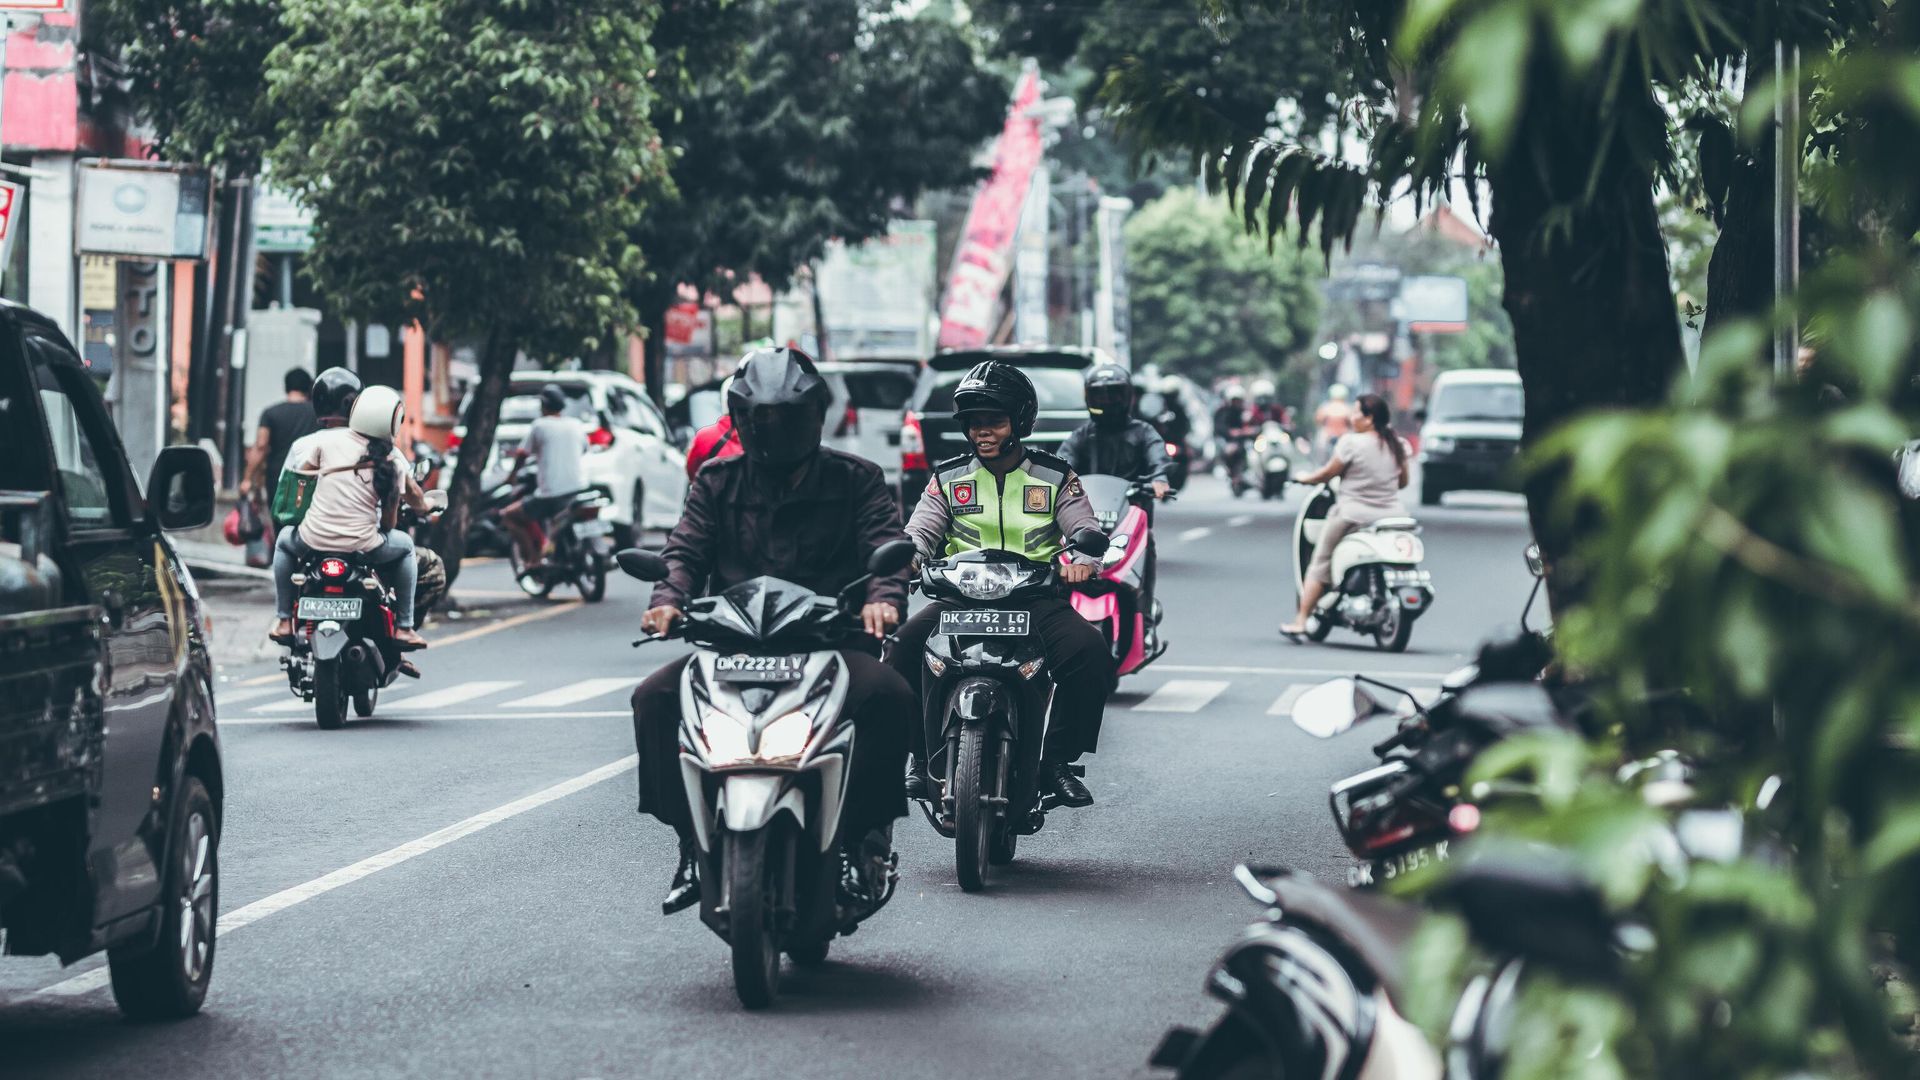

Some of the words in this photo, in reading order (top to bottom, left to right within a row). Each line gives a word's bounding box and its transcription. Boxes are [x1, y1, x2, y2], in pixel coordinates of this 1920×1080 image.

[942, 613, 960, 623] DK
[964, 613, 1000, 623] 2752
[1008, 613, 1025, 623] LG
